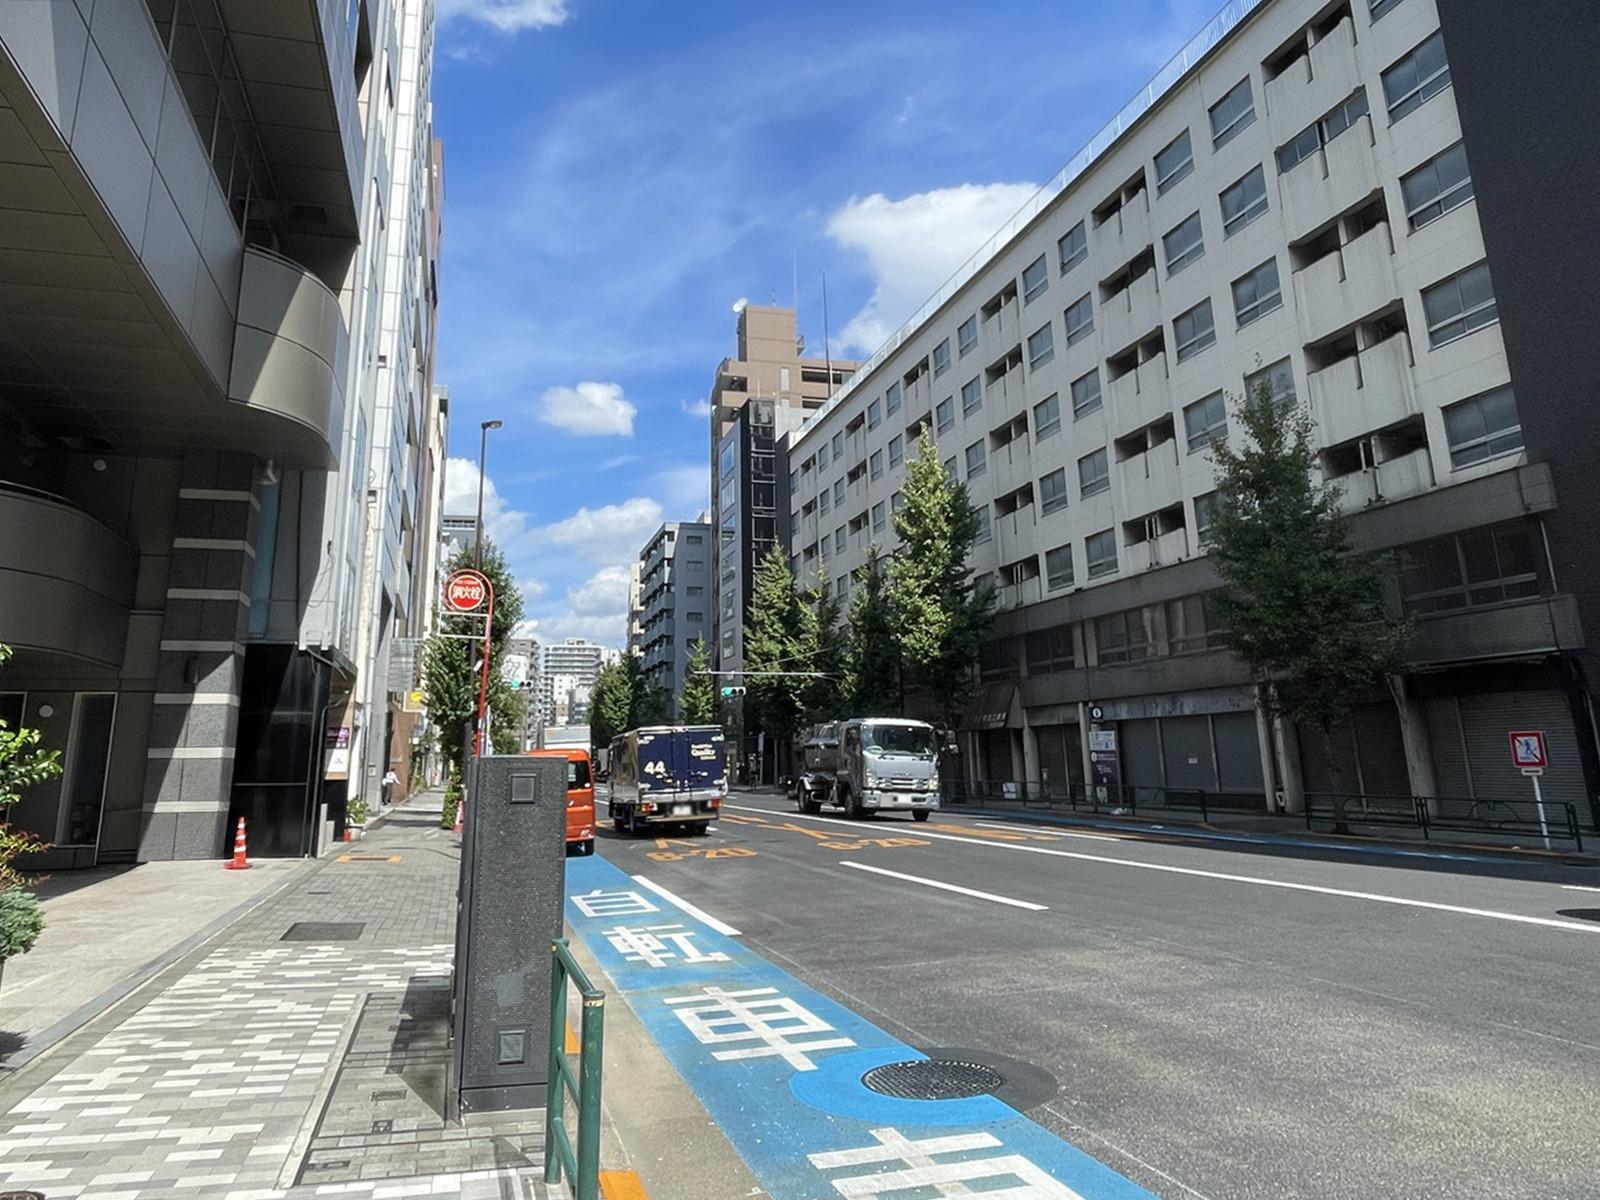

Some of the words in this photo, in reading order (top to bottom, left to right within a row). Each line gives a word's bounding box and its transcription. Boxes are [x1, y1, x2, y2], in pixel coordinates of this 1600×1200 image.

[452, 586, 481, 599] 消火栓
[644, 761, 666, 775] 44
[818, 837, 932, 851] 8-20
[646, 847, 758, 861] 8-20
